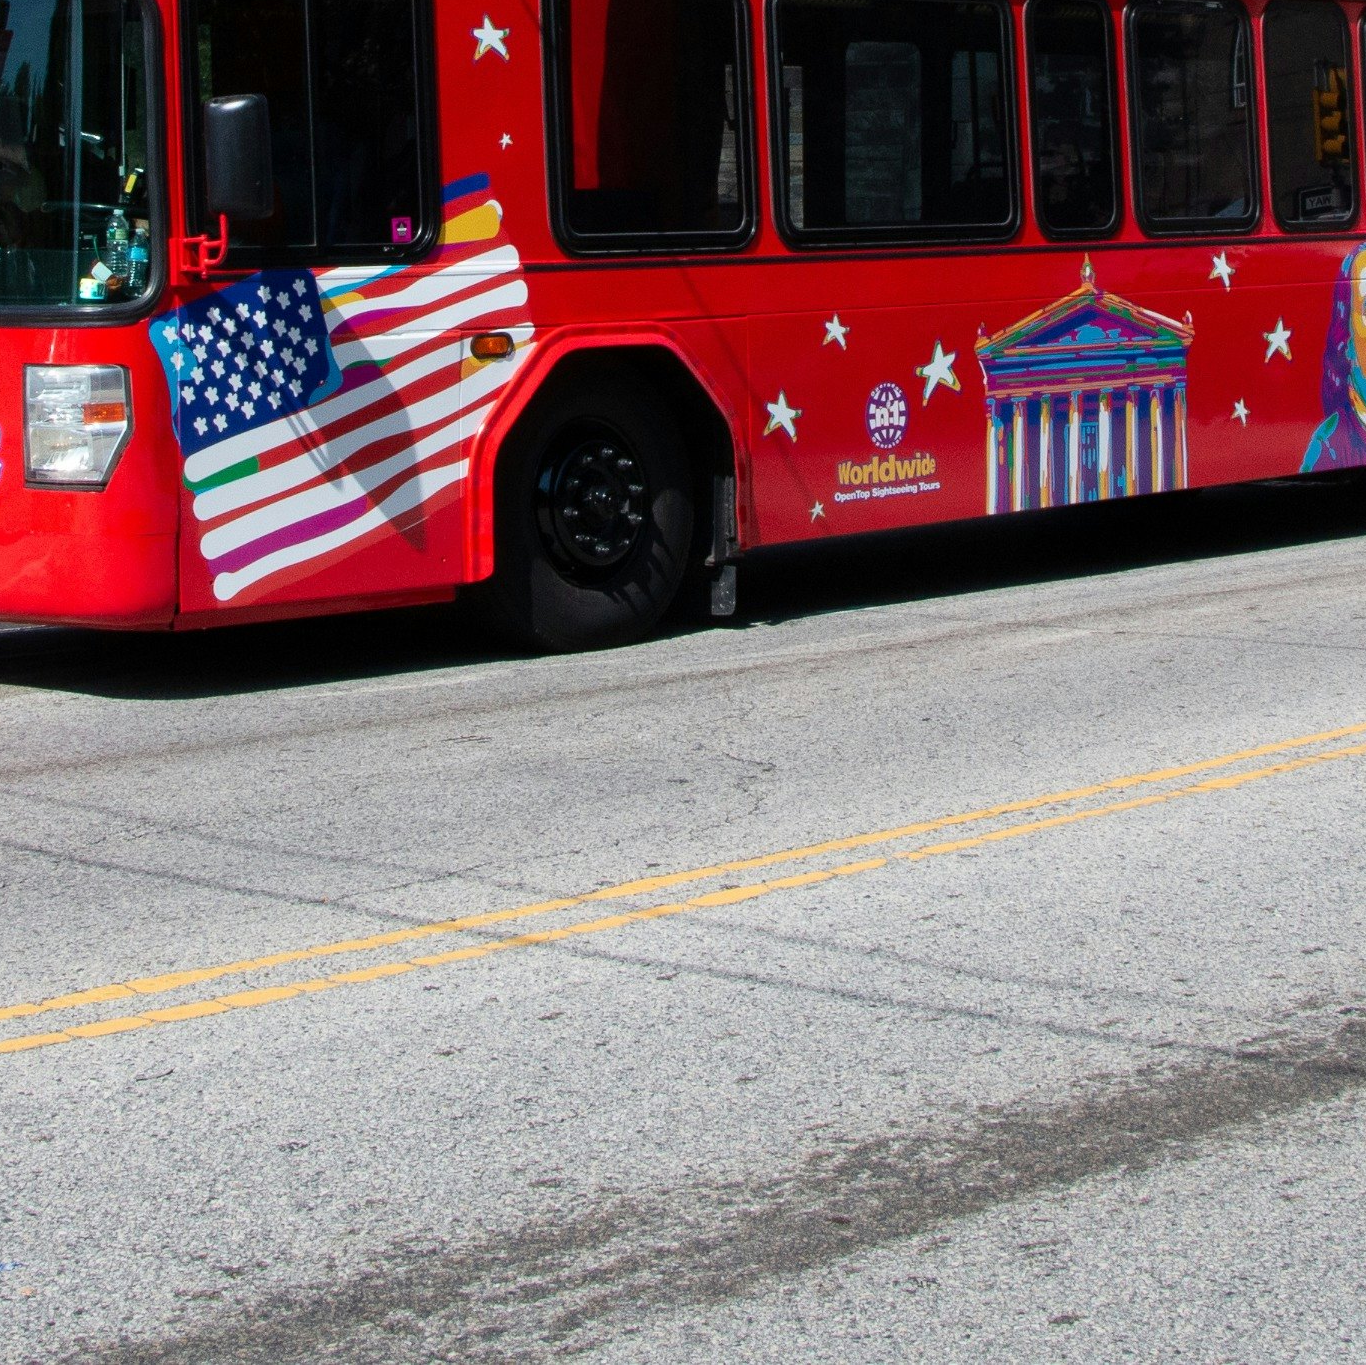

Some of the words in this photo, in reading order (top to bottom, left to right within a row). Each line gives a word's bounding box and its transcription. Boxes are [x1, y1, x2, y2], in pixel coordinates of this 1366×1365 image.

[838, 452, 936, 485] Worldwide
[872, 484, 918, 497] Sightseeing
[918, 481, 940, 491] Tours
